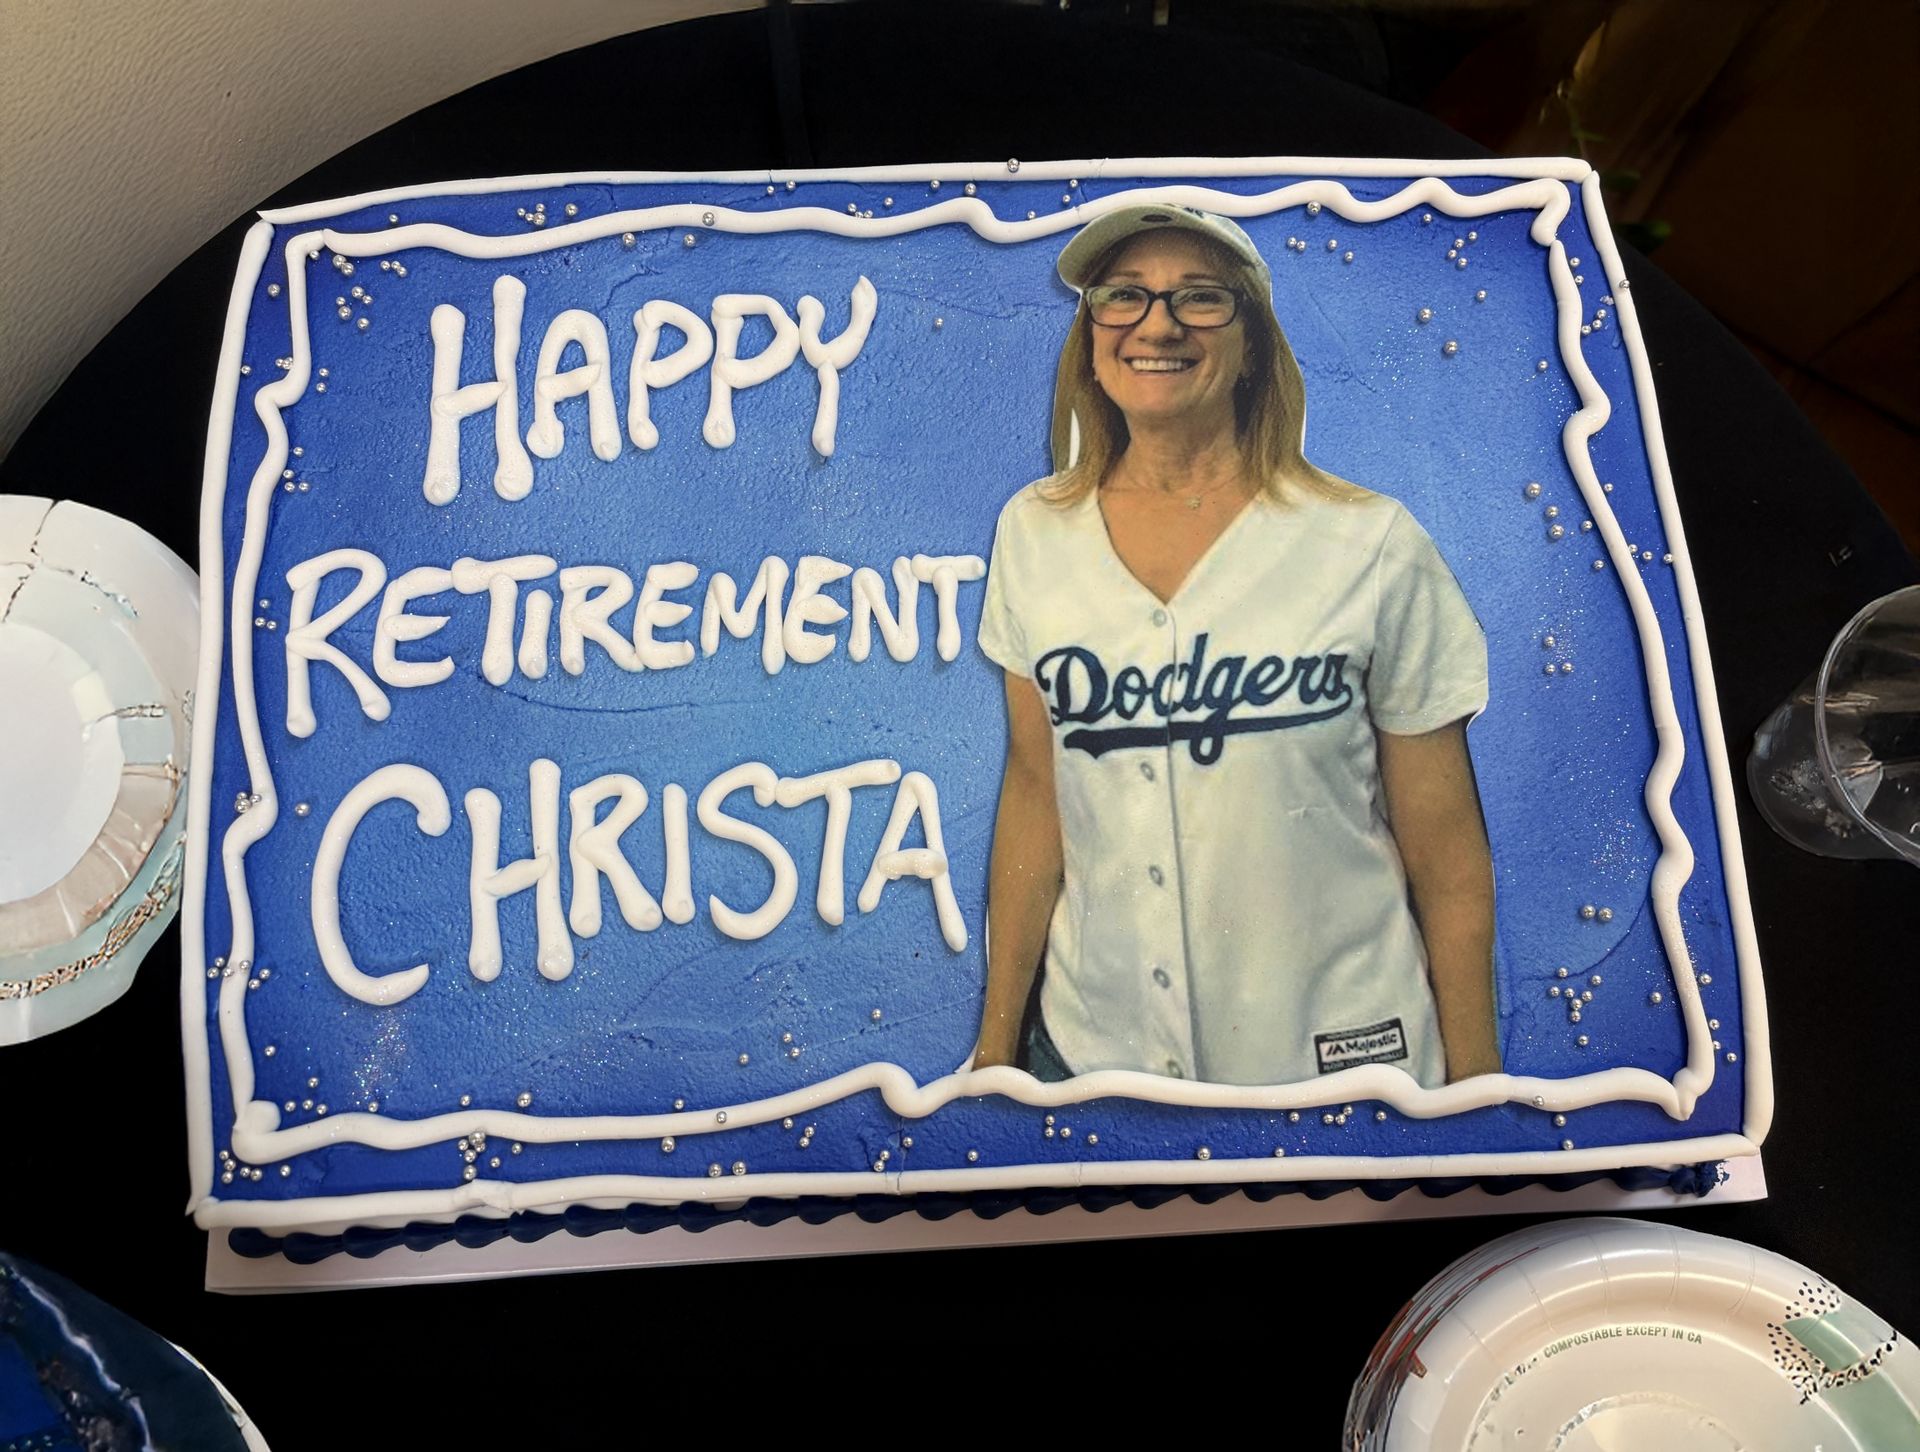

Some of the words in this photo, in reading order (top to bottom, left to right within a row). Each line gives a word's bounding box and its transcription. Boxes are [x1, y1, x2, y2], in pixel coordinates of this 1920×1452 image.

[423, 274, 879, 506] HAPPY
[284, 548, 987, 738] RETIREMENT
[1034, 633, 1353, 766] Dodgers
[311, 758, 968, 1006] CHRISTA
[1345, 1033, 1397, 1053] Majestic
[1543, 1327, 1622, 1358] COMPOSTABLE
[1626, 1326, 1668, 1337] EXCEPT
[1672, 1328, 1684, 1340] IN
[1687, 1331, 1702, 1345] CA
